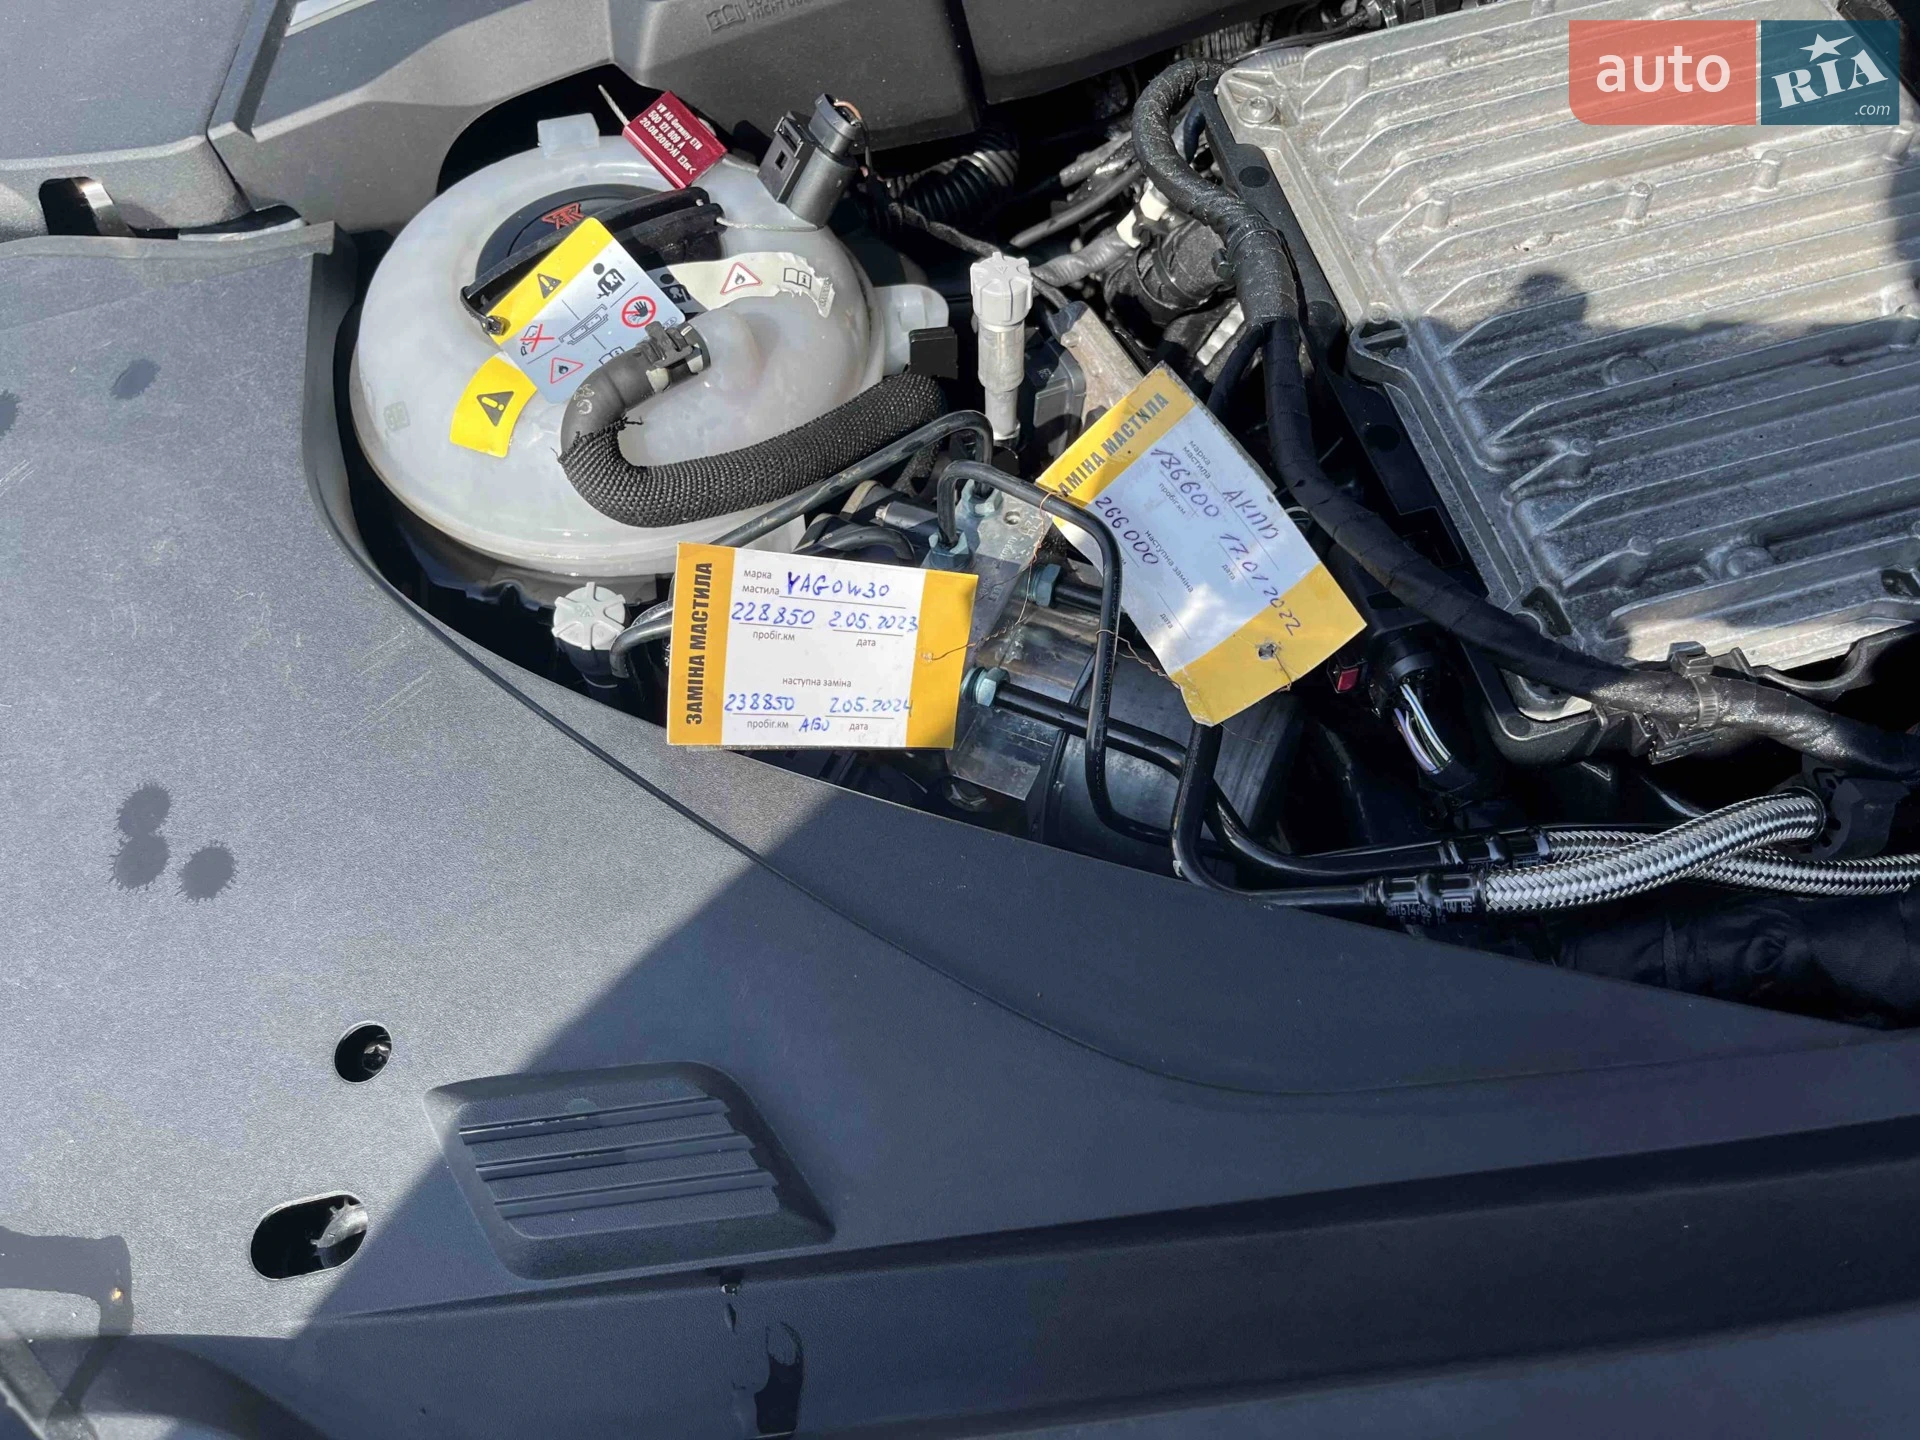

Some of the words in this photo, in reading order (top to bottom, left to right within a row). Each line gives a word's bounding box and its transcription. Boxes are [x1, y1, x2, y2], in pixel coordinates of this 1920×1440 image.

[663, 111, 674, 122] AG
[670, 118, 692, 141] Germany
[1057, 451, 1106, 498] АМІНА
[1101, 393, 1169, 456] МАСТИЛА
[1188, 440, 1212, 467] марка
[1182, 446, 1212, 480] мастила
[1145, 529, 1175, 569] наступна
[1171, 565, 1195, 594] заміна
[1222, 562, 1237, 582] дата
[744, 569, 772, 581] марка
[742, 584, 780, 597] мастила
[689, 562, 713, 651] МАСТИЛА
[1160, 611, 1174, 630] дата
[752, 630, 796, 642] пробіг.км
[856, 637, 877, 648] дата
[686, 654, 706, 725] ЗАМІНА
[782, 677, 821, 688] наступна
[822, 678, 852, 688] заміна
[747, 718, 789, 730] пробіг.км
[849, 721, 869, 732] дата
